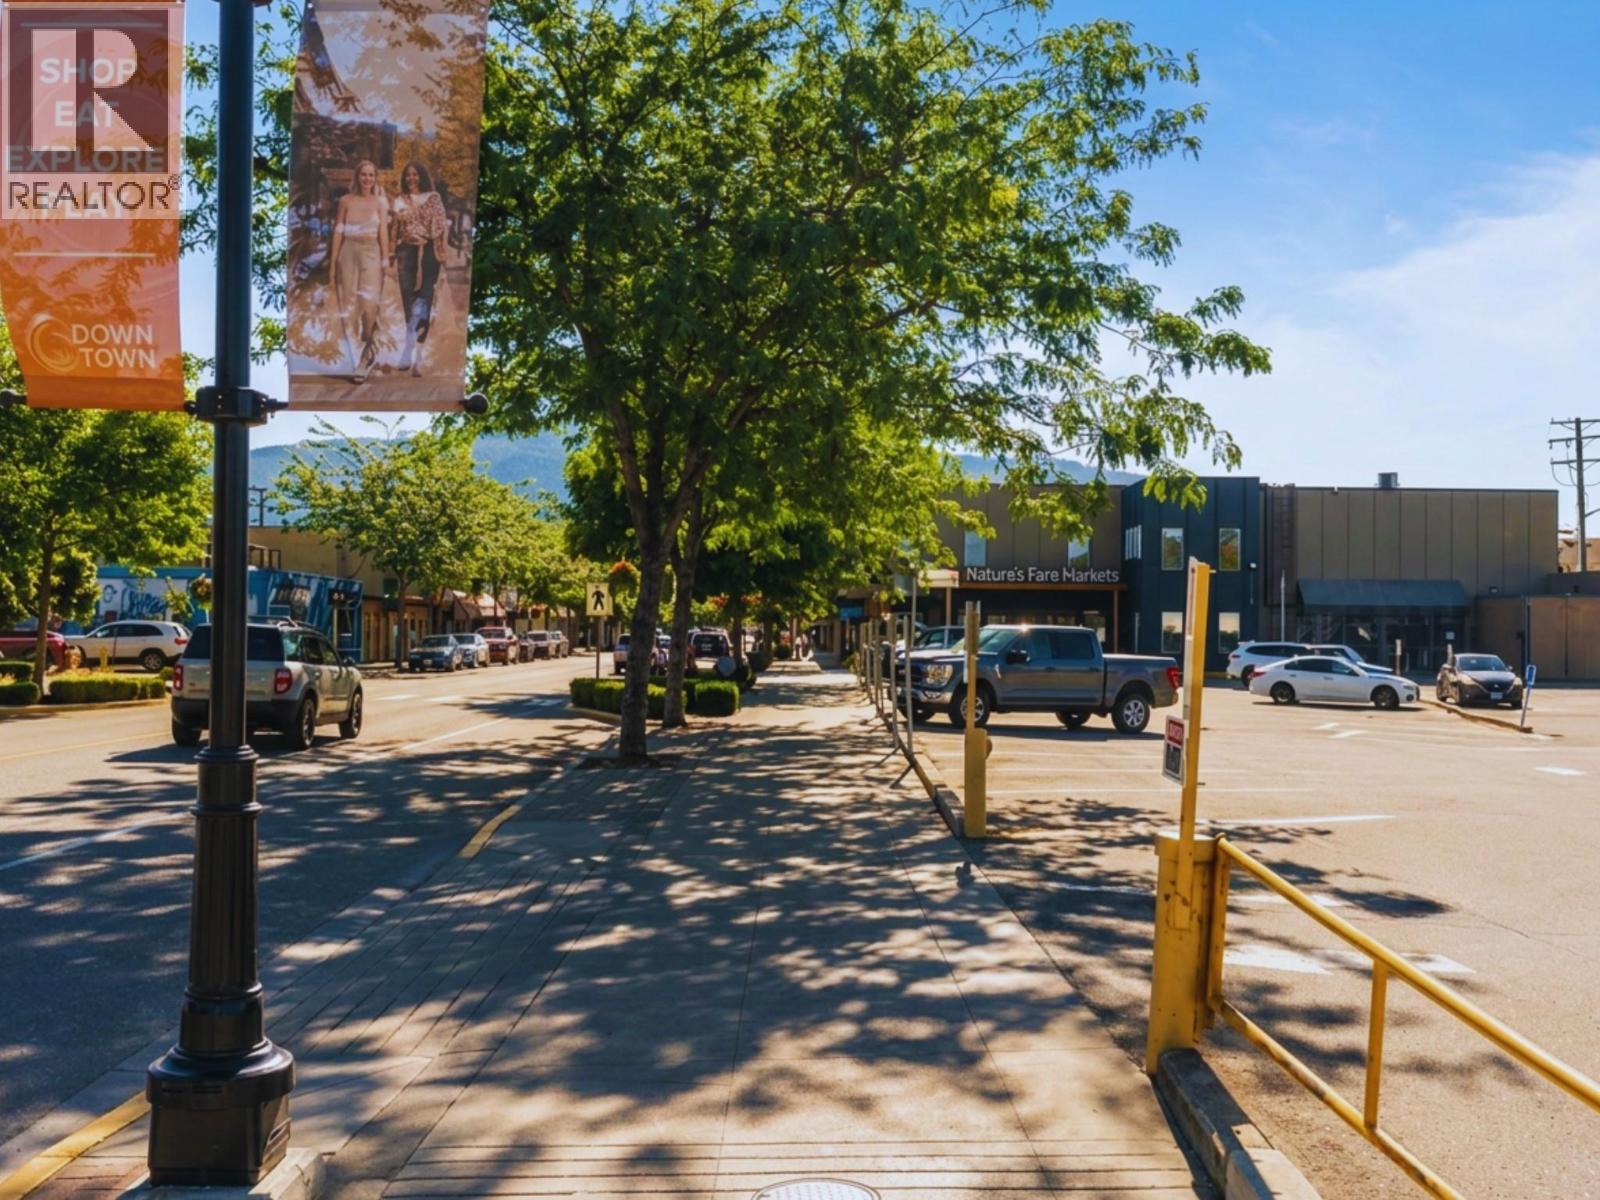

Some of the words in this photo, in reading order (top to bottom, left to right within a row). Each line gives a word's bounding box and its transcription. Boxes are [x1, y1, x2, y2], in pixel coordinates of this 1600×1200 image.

[40, 58, 138, 84] SHOP
[55, 100, 120, 127] EAT
[7, 145, 164, 171] EXPLORE
[72, 324, 153, 345] DOWN
[79, 348, 156, 368] TOWN
[966, 567, 1024, 581] Nature's
[1028, 567, 1059, 581] Fare
[1063, 568, 1119, 582] Markets
